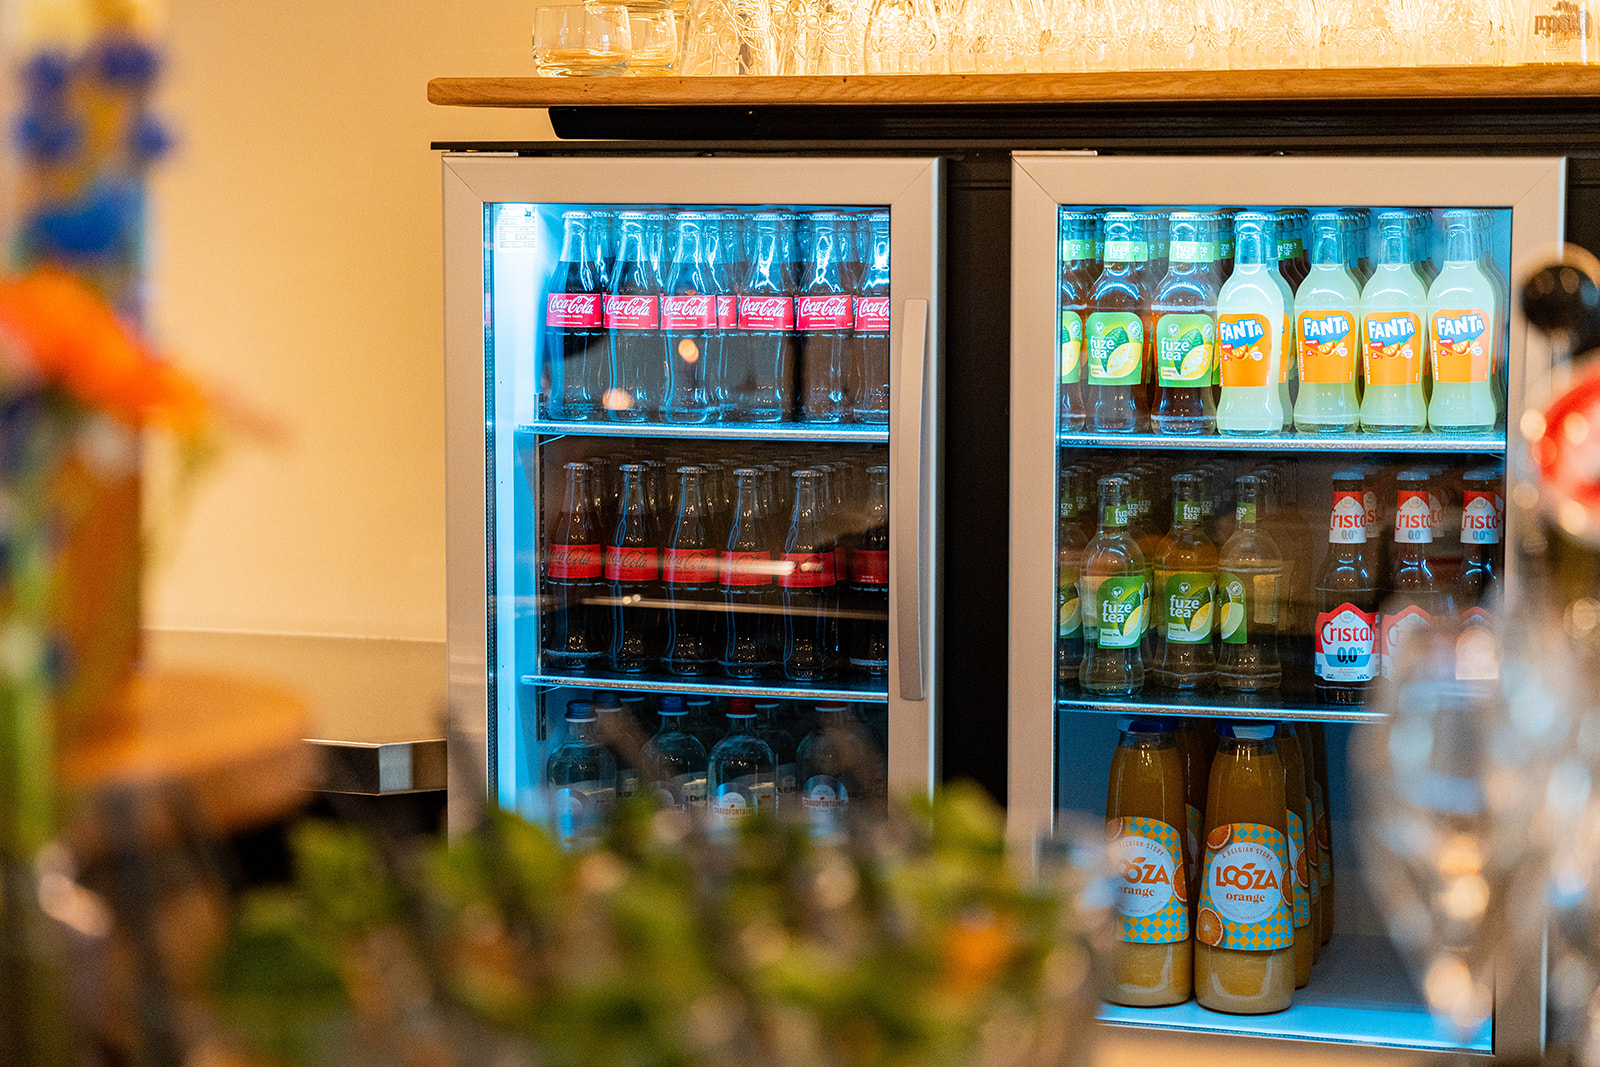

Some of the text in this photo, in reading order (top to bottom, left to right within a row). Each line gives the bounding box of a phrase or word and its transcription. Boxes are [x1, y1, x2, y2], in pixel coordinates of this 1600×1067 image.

[1110, 242, 1130, 253] fuze
[1176, 243, 1197, 253] fuze
[1176, 252, 1193, 260] tea
[550, 295, 596, 314] Coca-Cola
[606, 296, 653, 316] Coca-Cola
[664, 297, 711, 316] Coca-Cola
[741, 297, 788, 317] Coca-Cola
[800, 297, 848, 316] Coca-Cola
[859, 298, 889, 317] Coca-C
[1220, 319, 1263, 341] FANTA
[1303, 316, 1349, 337] FANTA
[1368, 318, 1414, 339] FANTA
[1437, 315, 1484, 336] FANTA
[1090, 335, 1115, 350] fuze
[1161, 337, 1190, 351] fuze
[1090, 348, 1107, 359] tea
[1161, 350, 1182, 361] tea
[1184, 512, 1199, 520] tea
[1102, 600, 1132, 614] fuze
[1170, 594, 1200, 609] fuze
[1102, 612, 1125, 623] tea
[1169, 607, 1192, 618] tea
[1321, 620, 1373, 646] Cristal
[1337, 646, 1365, 664] 0,0%
[1120, 840, 1165, 856] ELGIAN STORY
[1227, 846, 1254, 857] BELGIAN
[1255, 848, 1273, 862] STORY
[1216, 864, 1279, 890] LOOZA
[1226, 891, 1266, 904] orange
